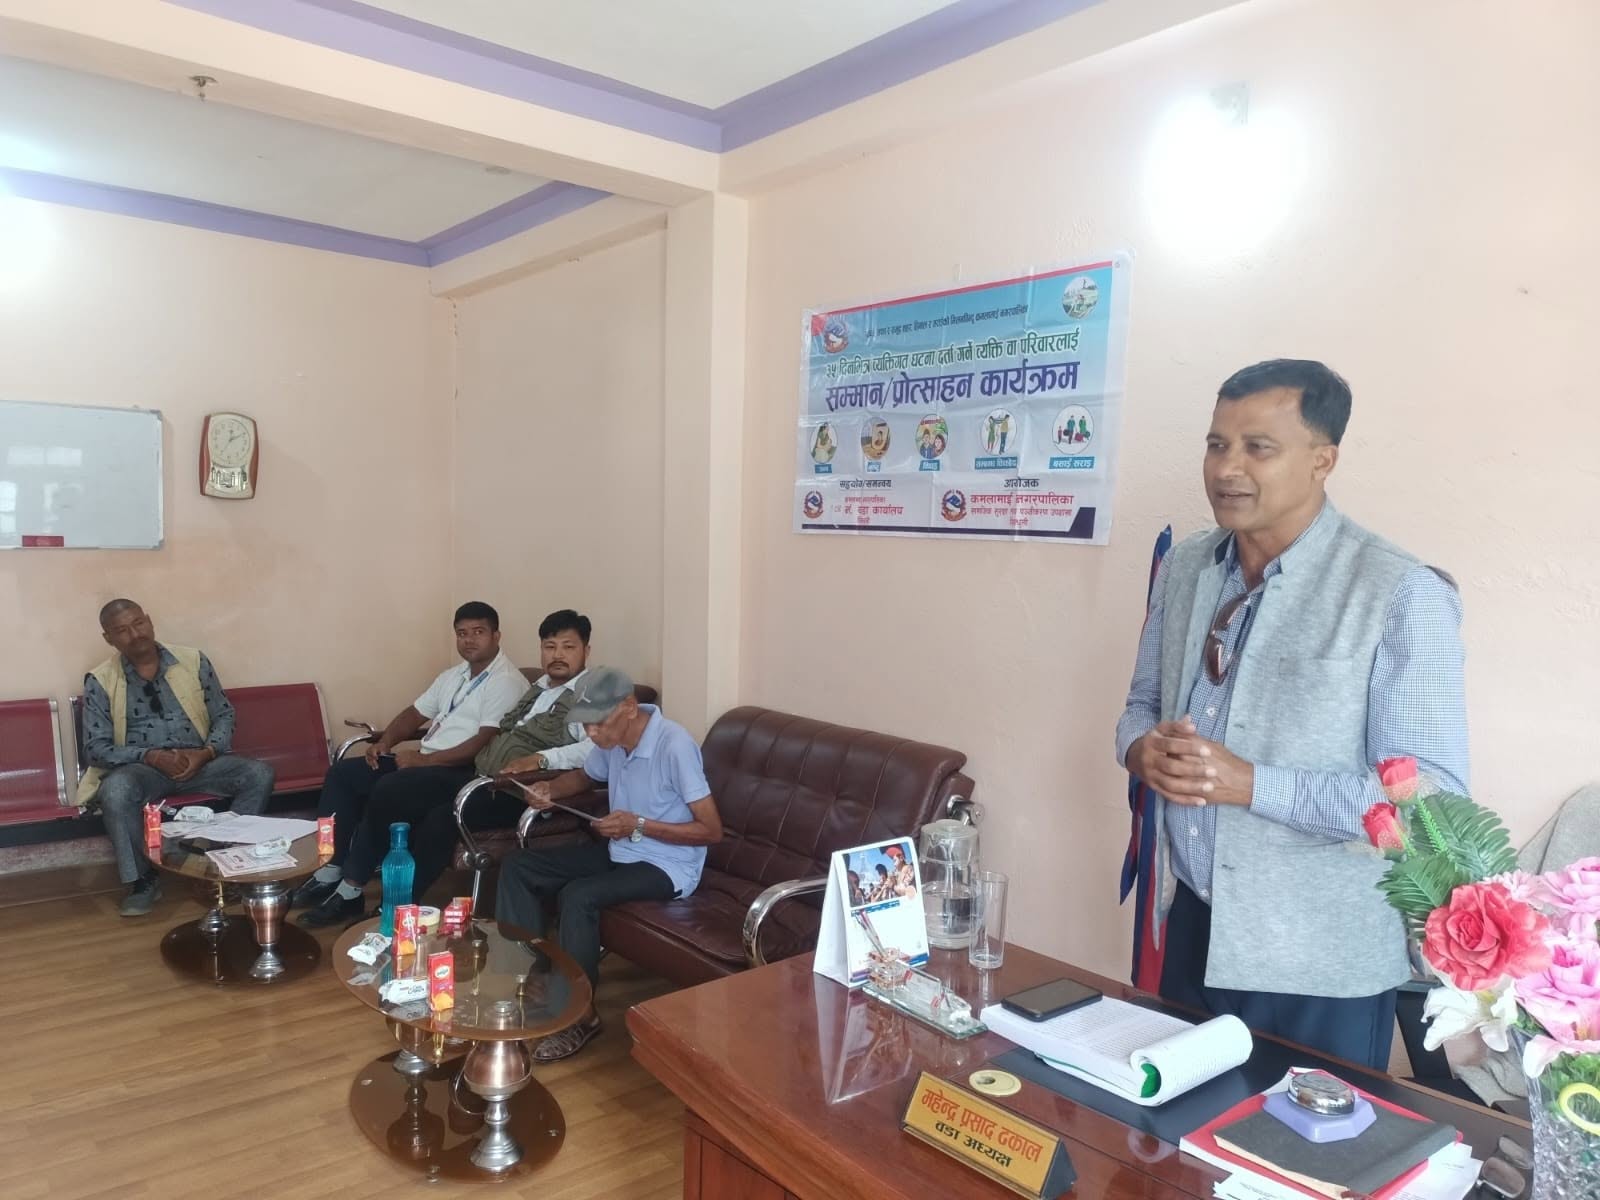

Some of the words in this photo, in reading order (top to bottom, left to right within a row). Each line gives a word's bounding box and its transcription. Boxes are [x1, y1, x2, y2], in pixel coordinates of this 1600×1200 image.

[839, 355, 871, 377] दिनभित्र
[872, 352, 910, 372] व्यक्तिगत
[911, 351, 936, 368] घटना
[938, 344, 955, 365] दर्ता
[976, 338, 1004, 359] व्यक्ति
[1006, 340, 1018, 356] वा
[1020, 328, 1080, 354] परिवारलाई
[980, 358, 1081, 397] कार्यक्रम
[970, 491, 1012, 505] कमलामाई
[1015, 491, 1075, 506] नगरपालिका
[1004, 476, 1040, 488] आयोजक
[922, 1089, 960, 1121] महेन्द्र
[959, 1107, 999, 1142] प्रसाद
[997, 1126, 1044, 1163] ढकाल
[934, 1119, 960, 1141] वडा
[963, 1134, 1013, 1168] अध्यक्ष
